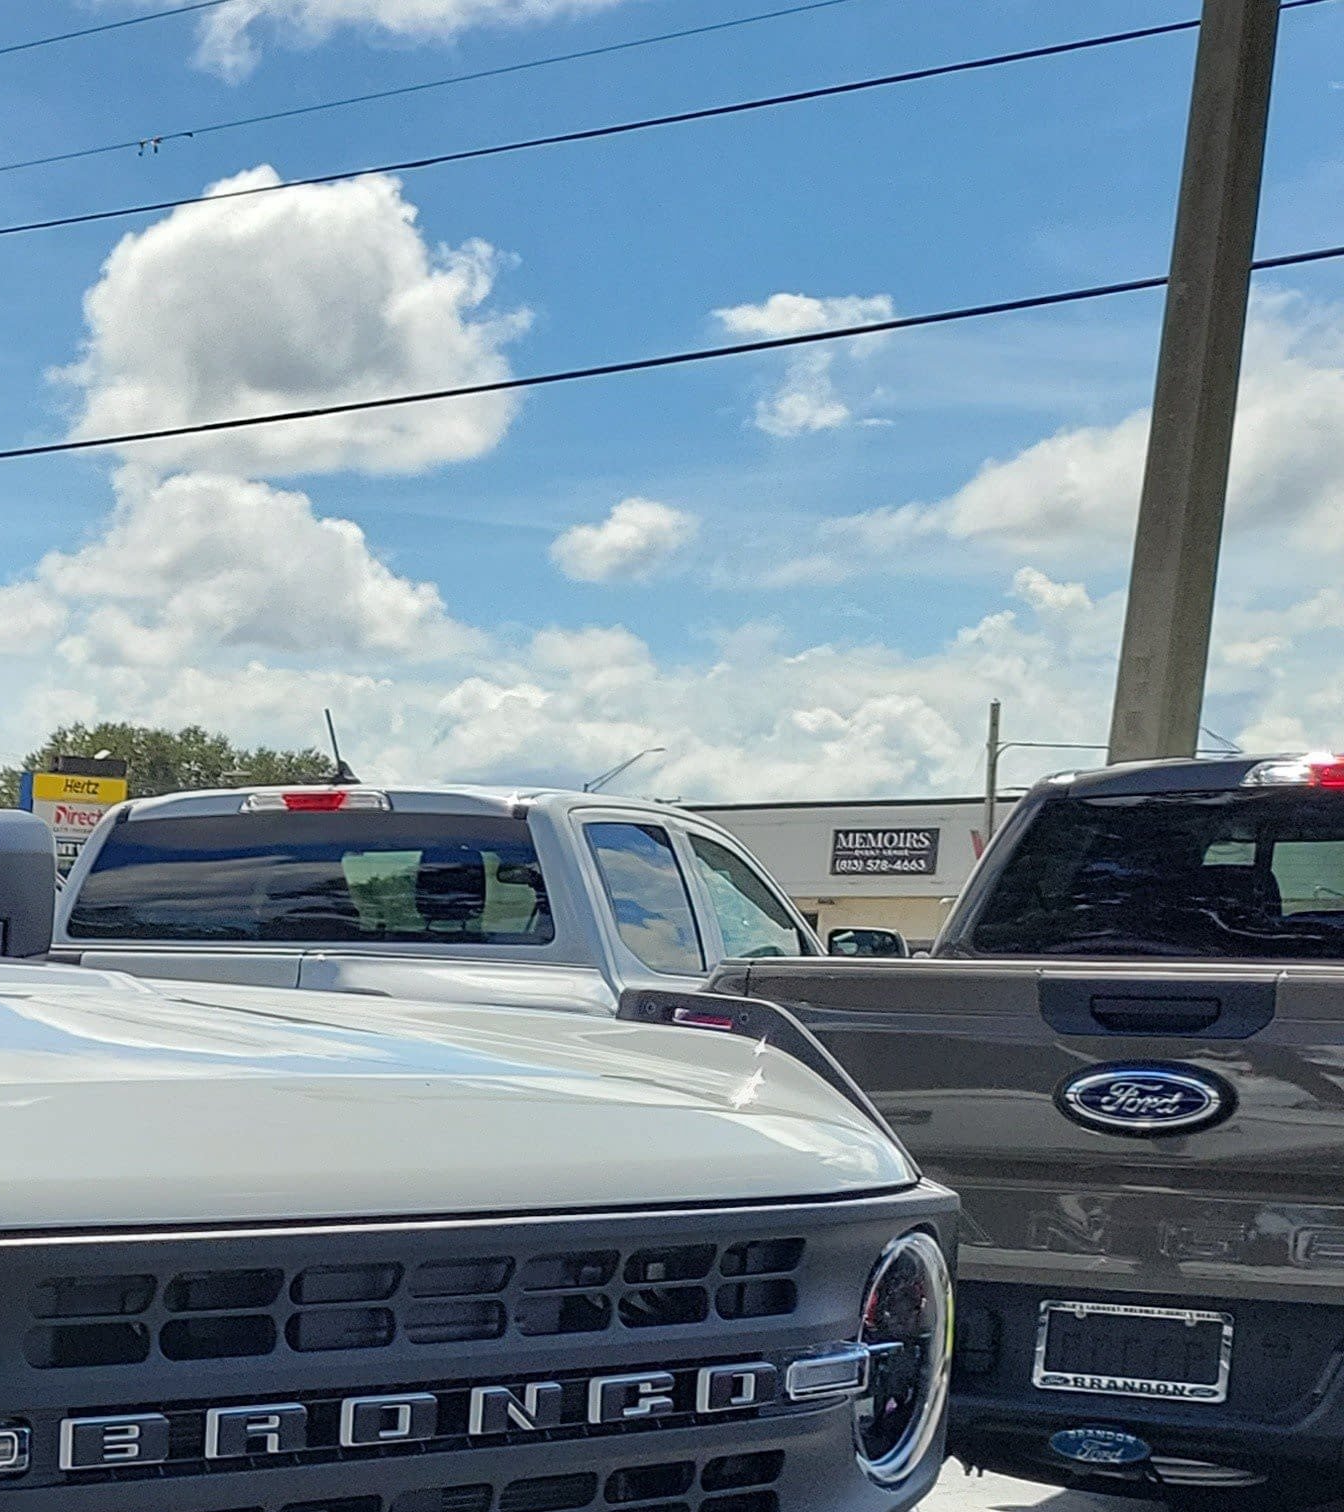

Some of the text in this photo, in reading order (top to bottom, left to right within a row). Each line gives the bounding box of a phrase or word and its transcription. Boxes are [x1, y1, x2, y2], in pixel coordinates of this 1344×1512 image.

[63, 779, 101, 795] Hertz
[836, 832, 931, 848] MEMOIRS
[1100, 1082, 1184, 1114] Ford
[1072, 1376, 1187, 1397] BRANDON
[59, 1361, 778, 1471] BRONCO
